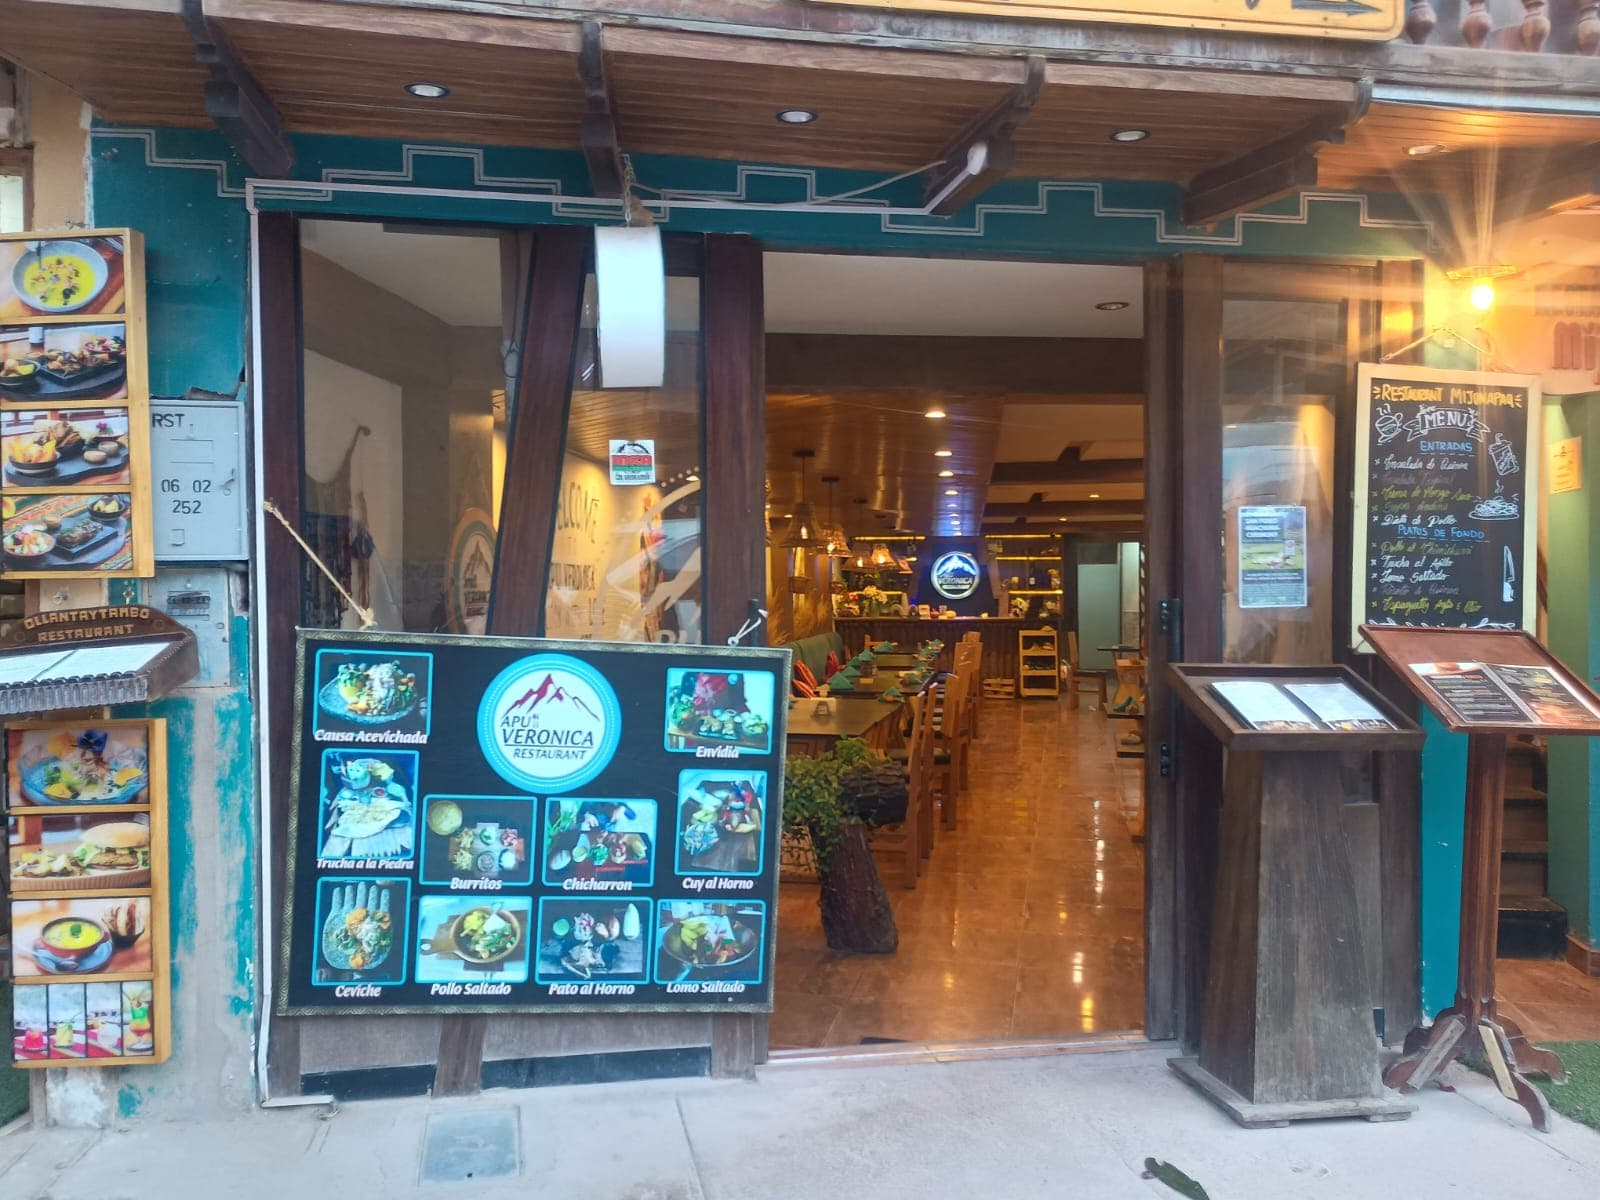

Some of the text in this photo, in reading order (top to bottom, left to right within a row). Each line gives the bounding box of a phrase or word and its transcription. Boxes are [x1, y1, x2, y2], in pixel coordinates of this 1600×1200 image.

[1420, 440, 1473, 452] ENTRADAS
[161, 479, 212, 493] 06 02
[172, 500, 202, 514] 252
[1427, 514, 1458, 527] Pollo
[1398, 524, 1428, 537] PLATOS
[1433, 528, 1446, 538] DE
[24, 606, 150, 630] OLLANTAYTAMBO
[38, 624, 134, 641] RESTAURANT
[500, 715, 530, 728] APU
[314, 729, 428, 745] Causa Acevichada
[502, 728, 595, 747] VERONICA
[513, 748, 587, 760] RESTAURANT
[316, 858, 414, 870] Trucha a la Piedra
[450, 877, 502, 890] Burritos
[562, 877, 633, 891] Chicharron
[682, 877, 754, 893] Cuy al Horno
[335, 984, 382, 998] Ceviche
[430, 982, 512, 996] Pollo Saltado
[548, 982, 635, 996] Pato al Horno
[666, 980, 745, 994] Lomo Saltado
